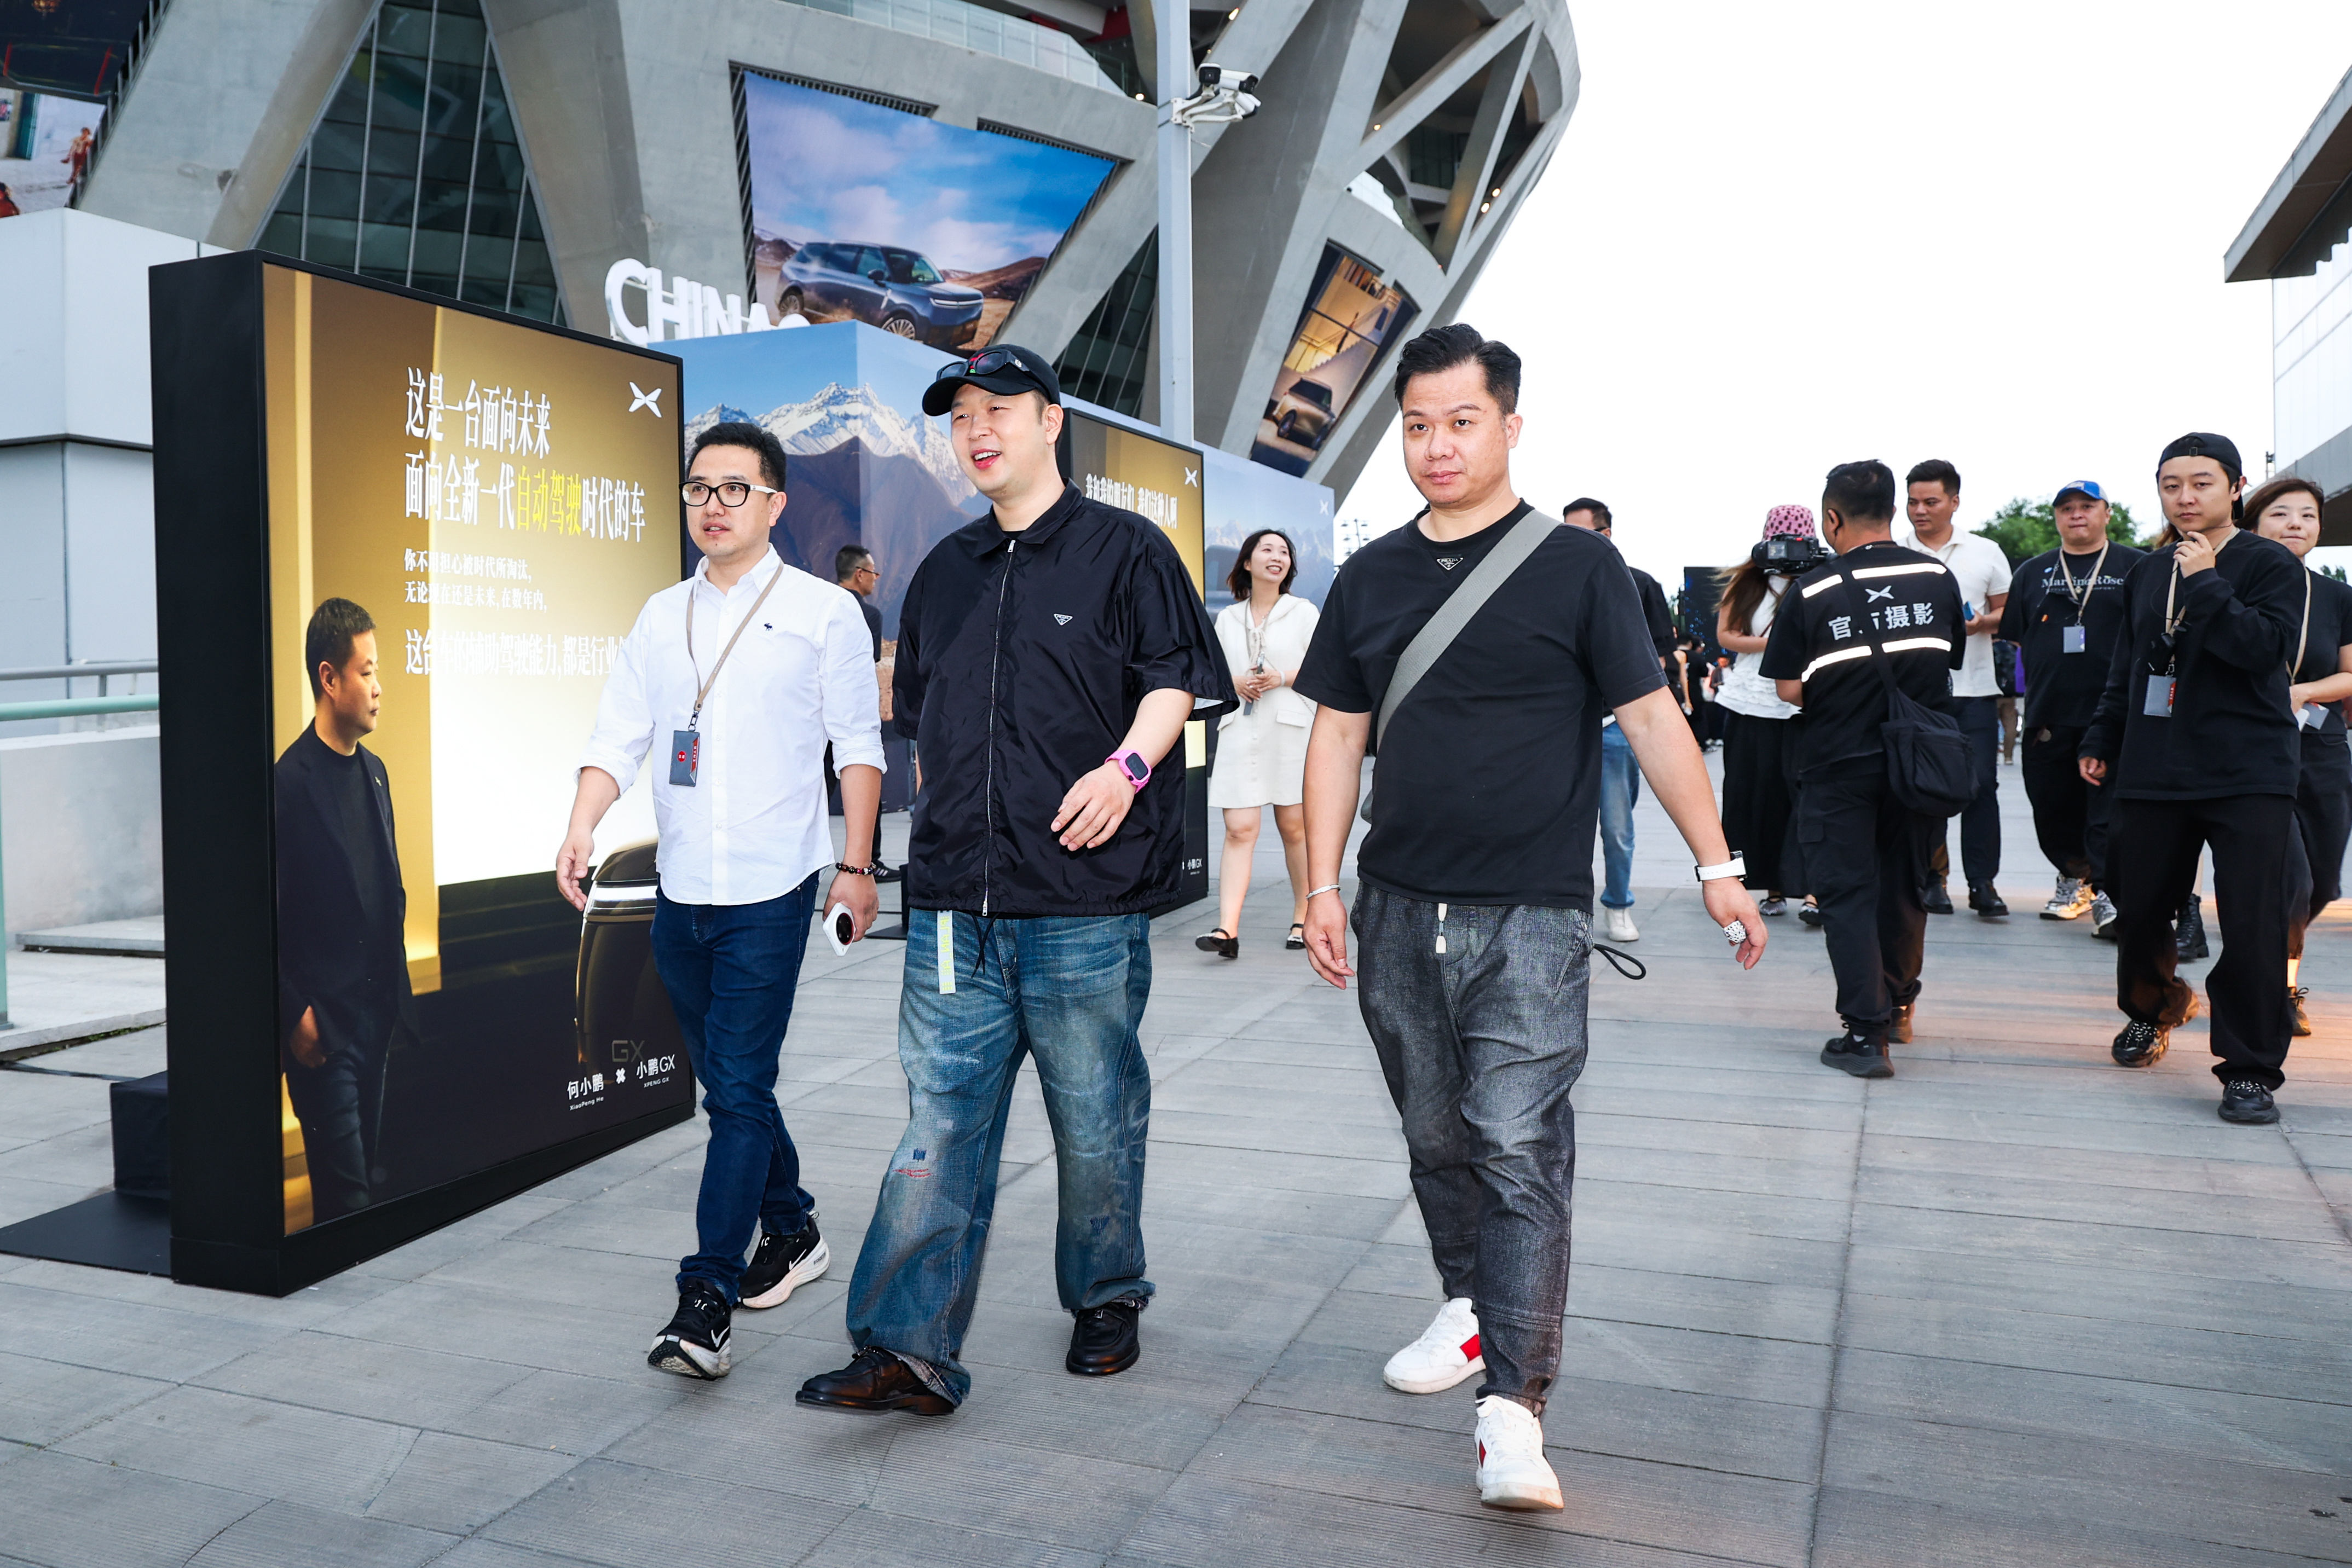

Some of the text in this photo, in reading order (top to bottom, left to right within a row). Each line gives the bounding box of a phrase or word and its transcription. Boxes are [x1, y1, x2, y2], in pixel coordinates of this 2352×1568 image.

[405, 367, 551, 459] 这是一台面向未来
[405, 449, 645, 542] 面向全新一代自动驾驶时代的车
[1828, 603, 1934, 640] 官摄影
[612, 1040, 645, 1062] GX
[636, 1054, 675, 1079] 小鹏GX
[567, 1073, 604, 1100] 何小鹏
[643, 1079, 661, 1088] XPENG
[570, 1099, 595, 1110] XiaoPeng
